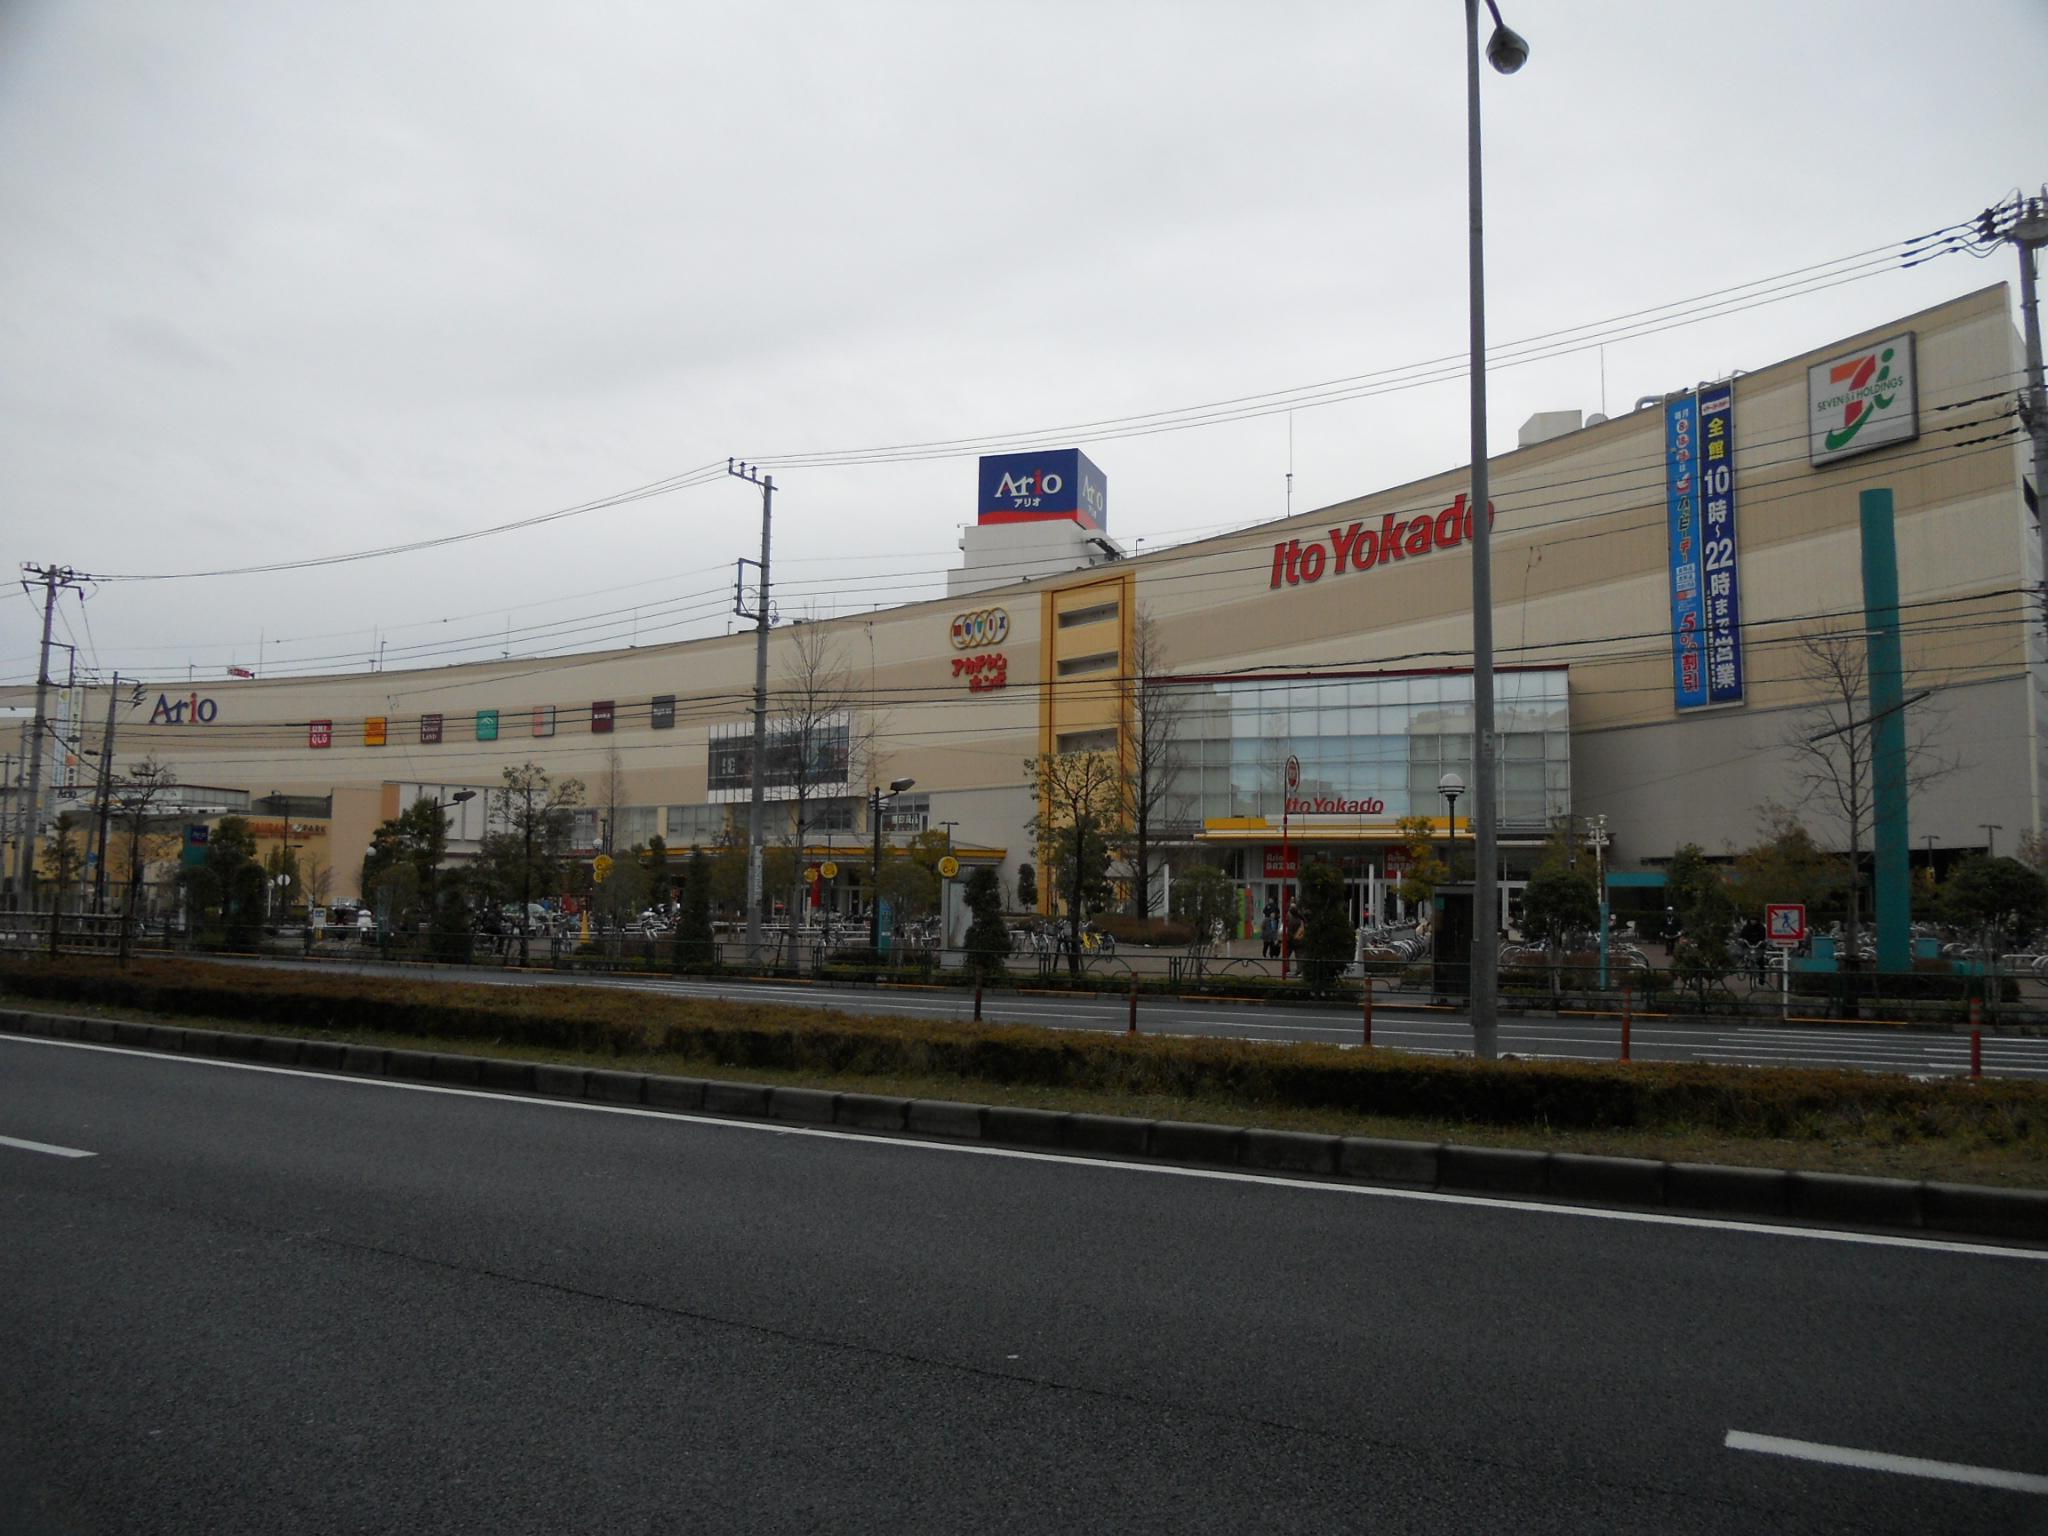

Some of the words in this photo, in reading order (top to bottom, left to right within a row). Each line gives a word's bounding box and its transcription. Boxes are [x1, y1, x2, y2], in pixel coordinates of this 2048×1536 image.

[1856, 376, 1903, 398] HOLDINGS
[994, 469, 1063, 497] Ario
[1014, 498, 1041, 508] アリオ
[149, 692, 218, 723] Ario
